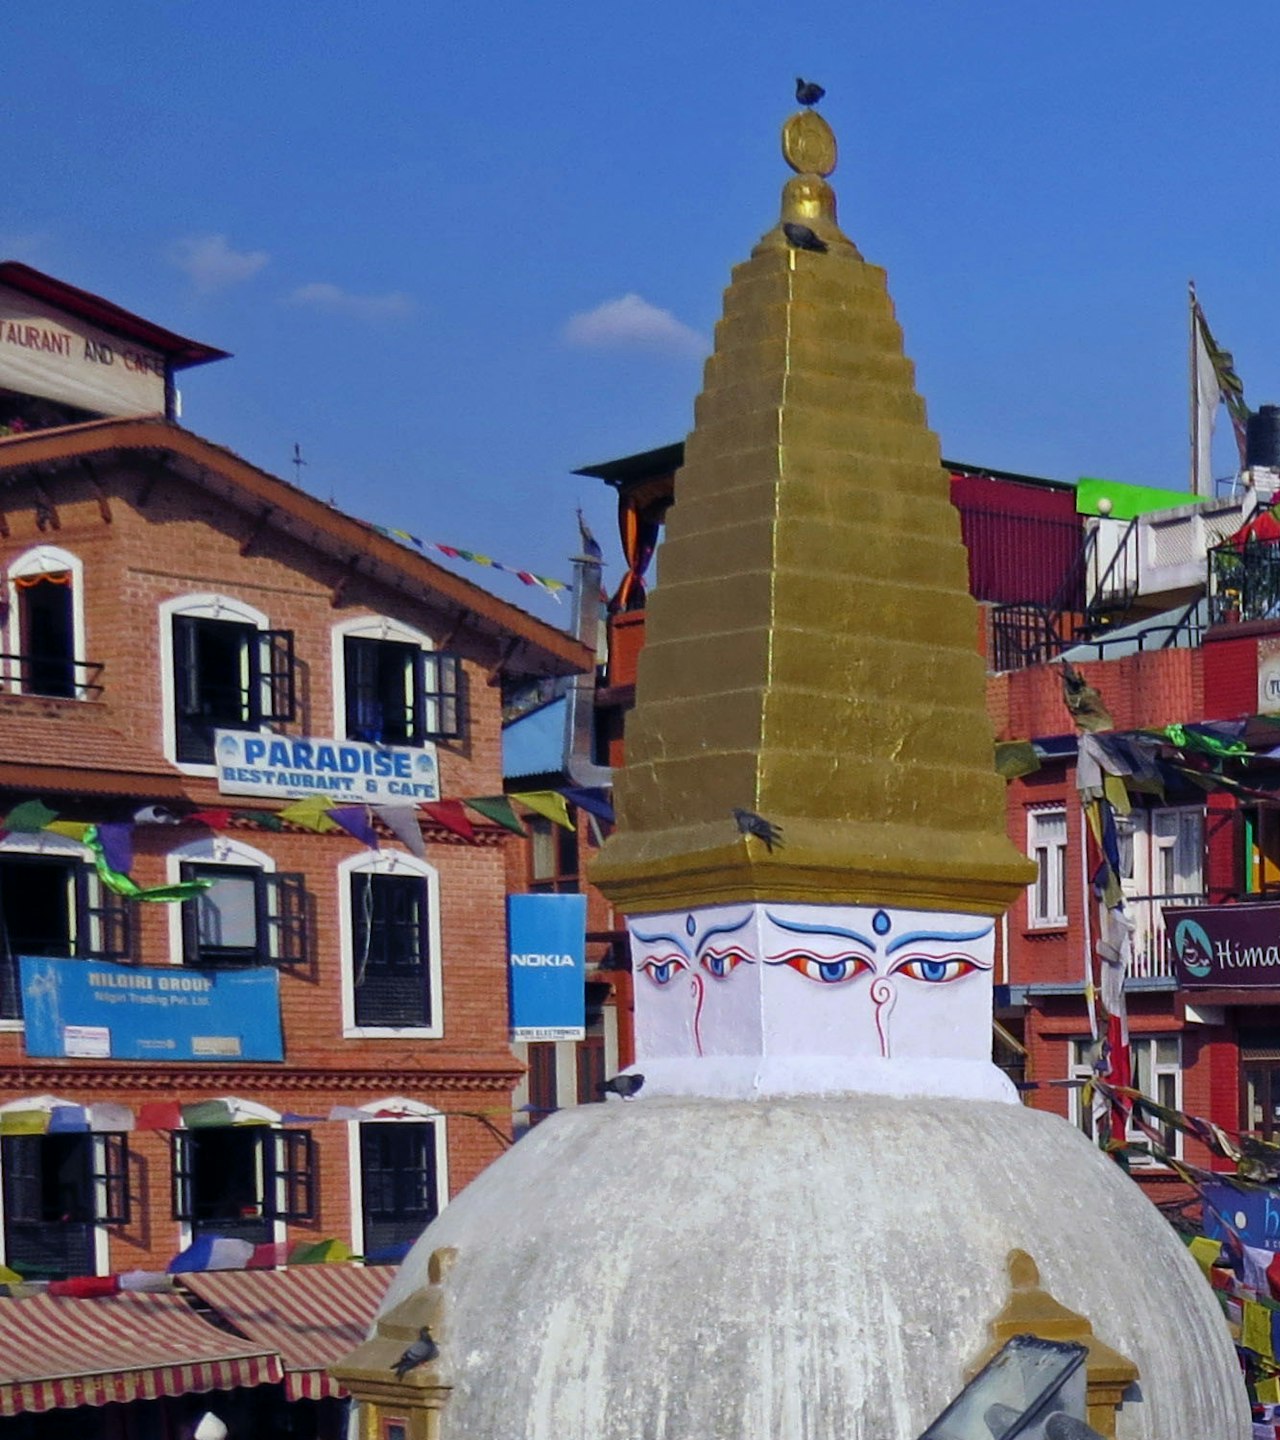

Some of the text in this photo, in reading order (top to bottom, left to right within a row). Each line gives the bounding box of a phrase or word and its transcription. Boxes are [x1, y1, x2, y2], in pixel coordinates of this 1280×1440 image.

[84, 339, 114, 366] AND
[243, 738, 413, 779] PARADISE
[223, 766, 355, 791] RESTAURANT
[388, 781, 436, 799] CAFE
[511, 953, 576, 967] NOKIA
[88, 972, 153, 990] NILGIRI
